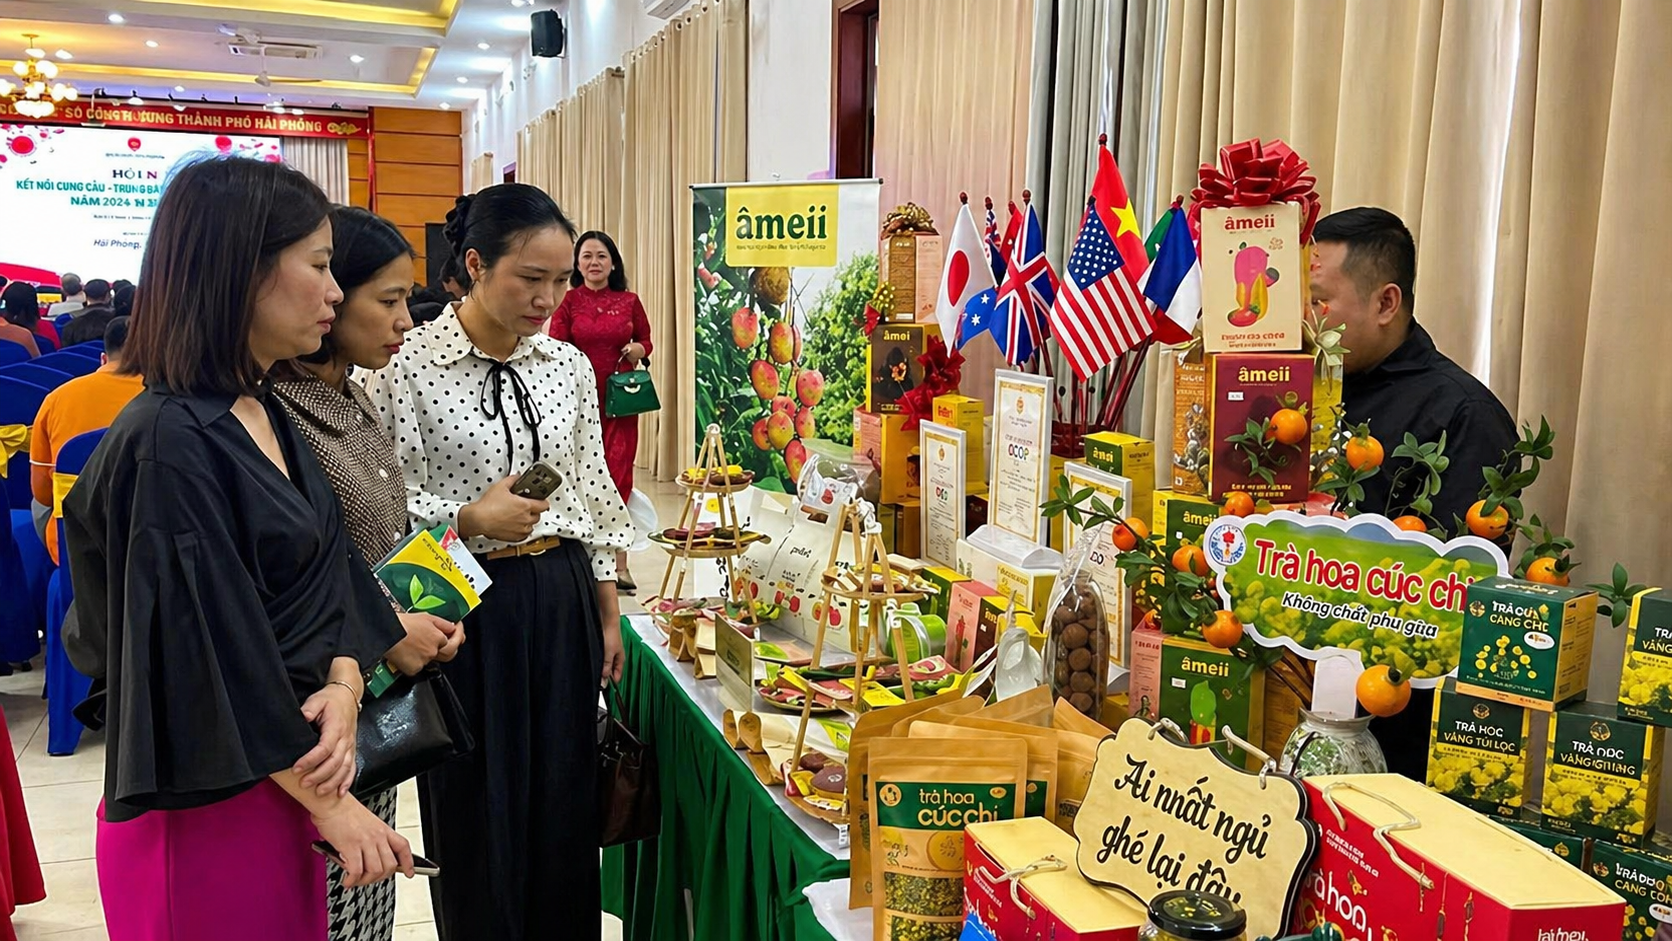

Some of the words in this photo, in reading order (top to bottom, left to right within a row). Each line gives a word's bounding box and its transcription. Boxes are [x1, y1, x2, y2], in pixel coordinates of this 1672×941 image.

[57, 181, 83, 192] CUNG
[736, 205, 827, 239] âmeii
[1224, 214, 1275, 230] âmeii
[1238, 366, 1291, 382] âmeii
[1255, 540, 1300, 580] Trà
[1305, 550, 1360, 592] hoa
[1367, 562, 1423, 603] cúc
[1429, 573, 1476, 611] ch
[1283, 593, 1330, 617] Không
[1489, 613, 1522, 628] CANG
[1181, 656, 1230, 677] âmeii
[1114, 753, 1156, 804] Ai
[944, 788, 975, 804] hoa
[1096, 815, 1149, 865] ghé
[1146, 833, 1186, 889] lại
